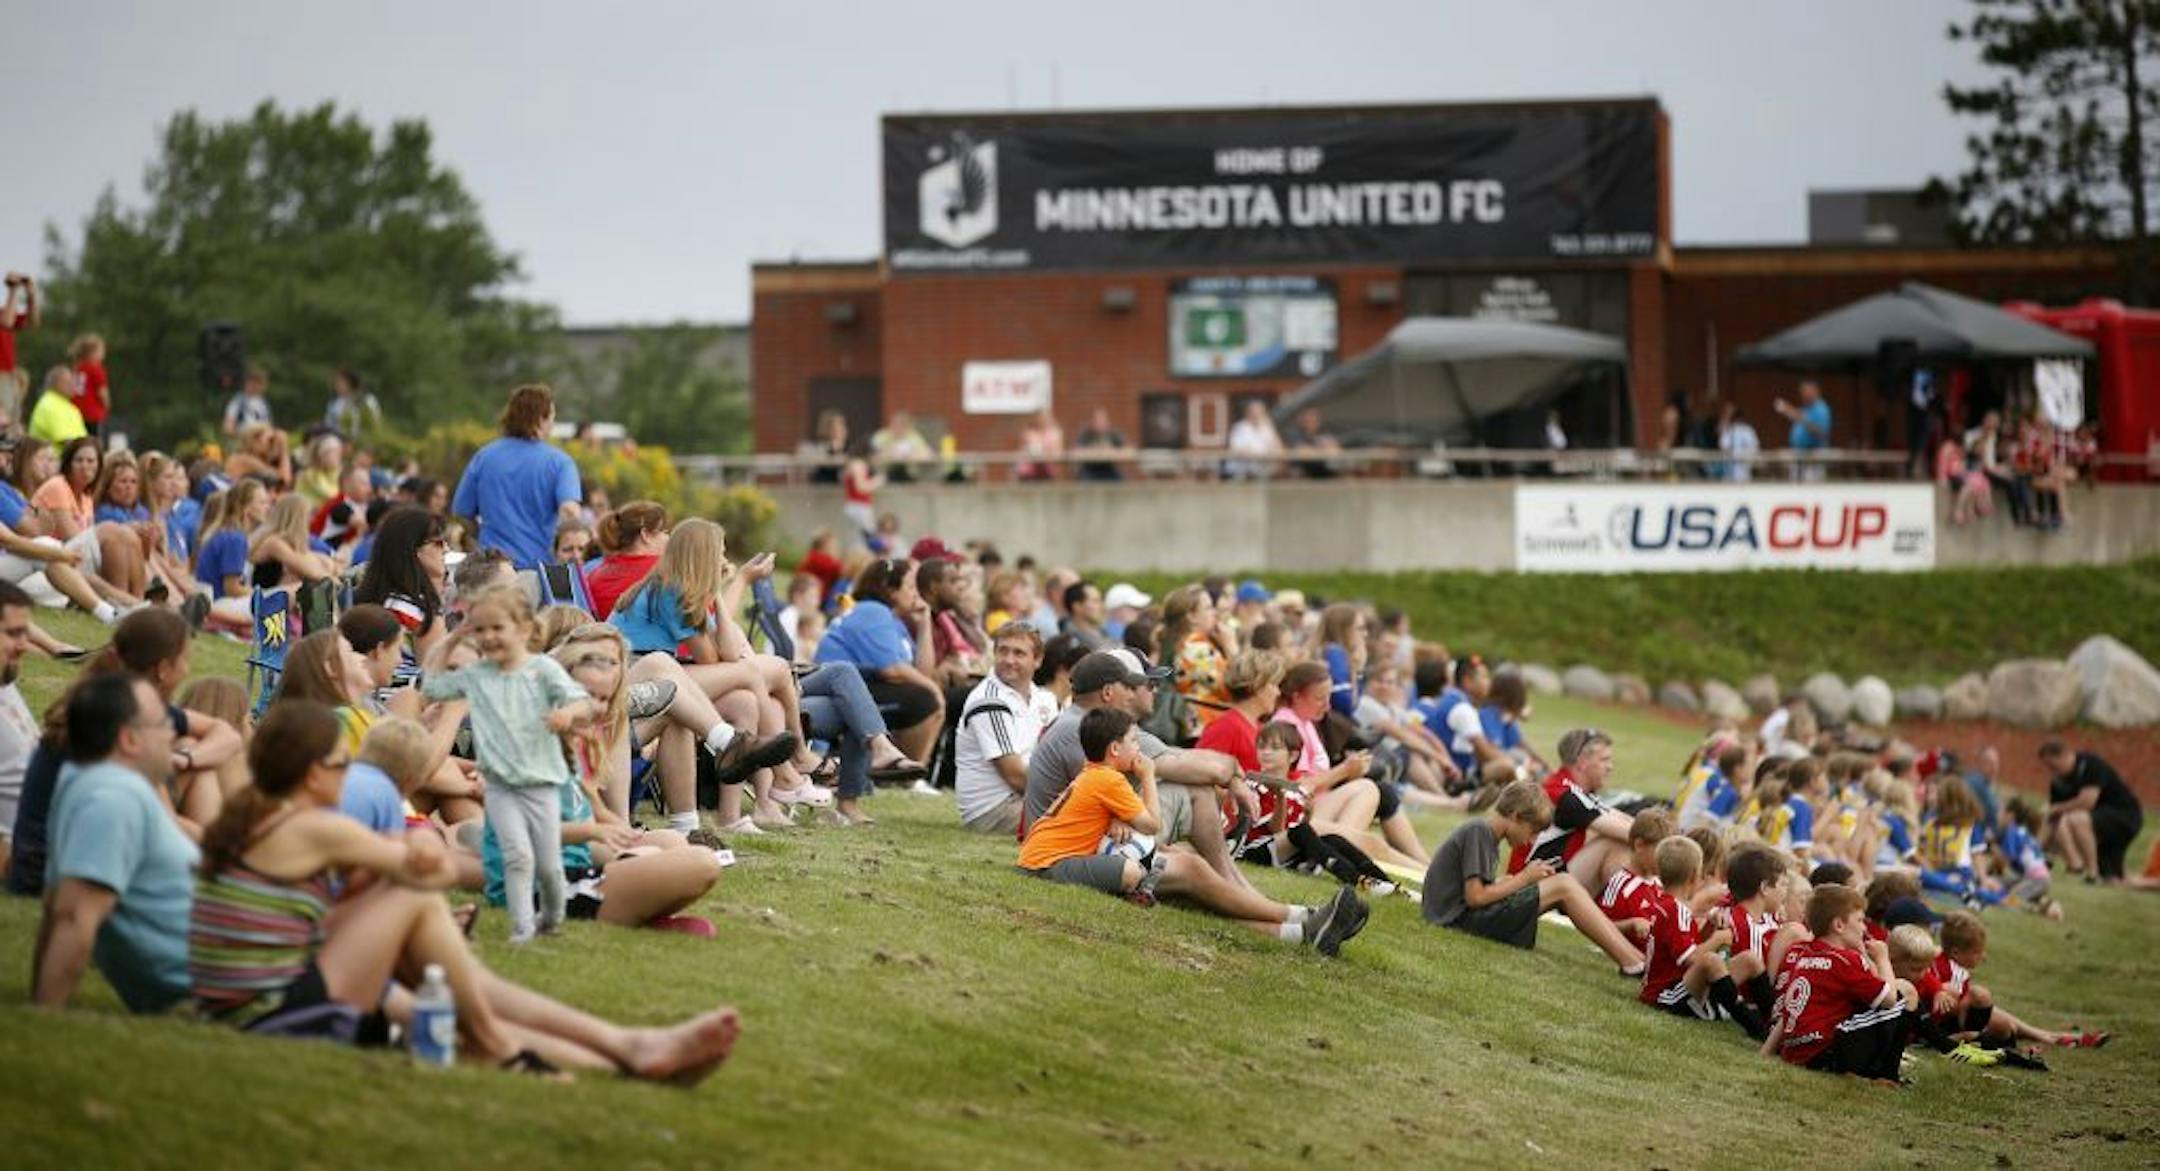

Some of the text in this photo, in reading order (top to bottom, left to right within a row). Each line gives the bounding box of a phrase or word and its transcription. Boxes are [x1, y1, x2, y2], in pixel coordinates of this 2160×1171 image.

[1214, 147, 1323, 175] HOME OF
[1035, 179, 1504, 231] MINNESOTA UNITED FC
[1631, 505, 1889, 550] USA CUP
